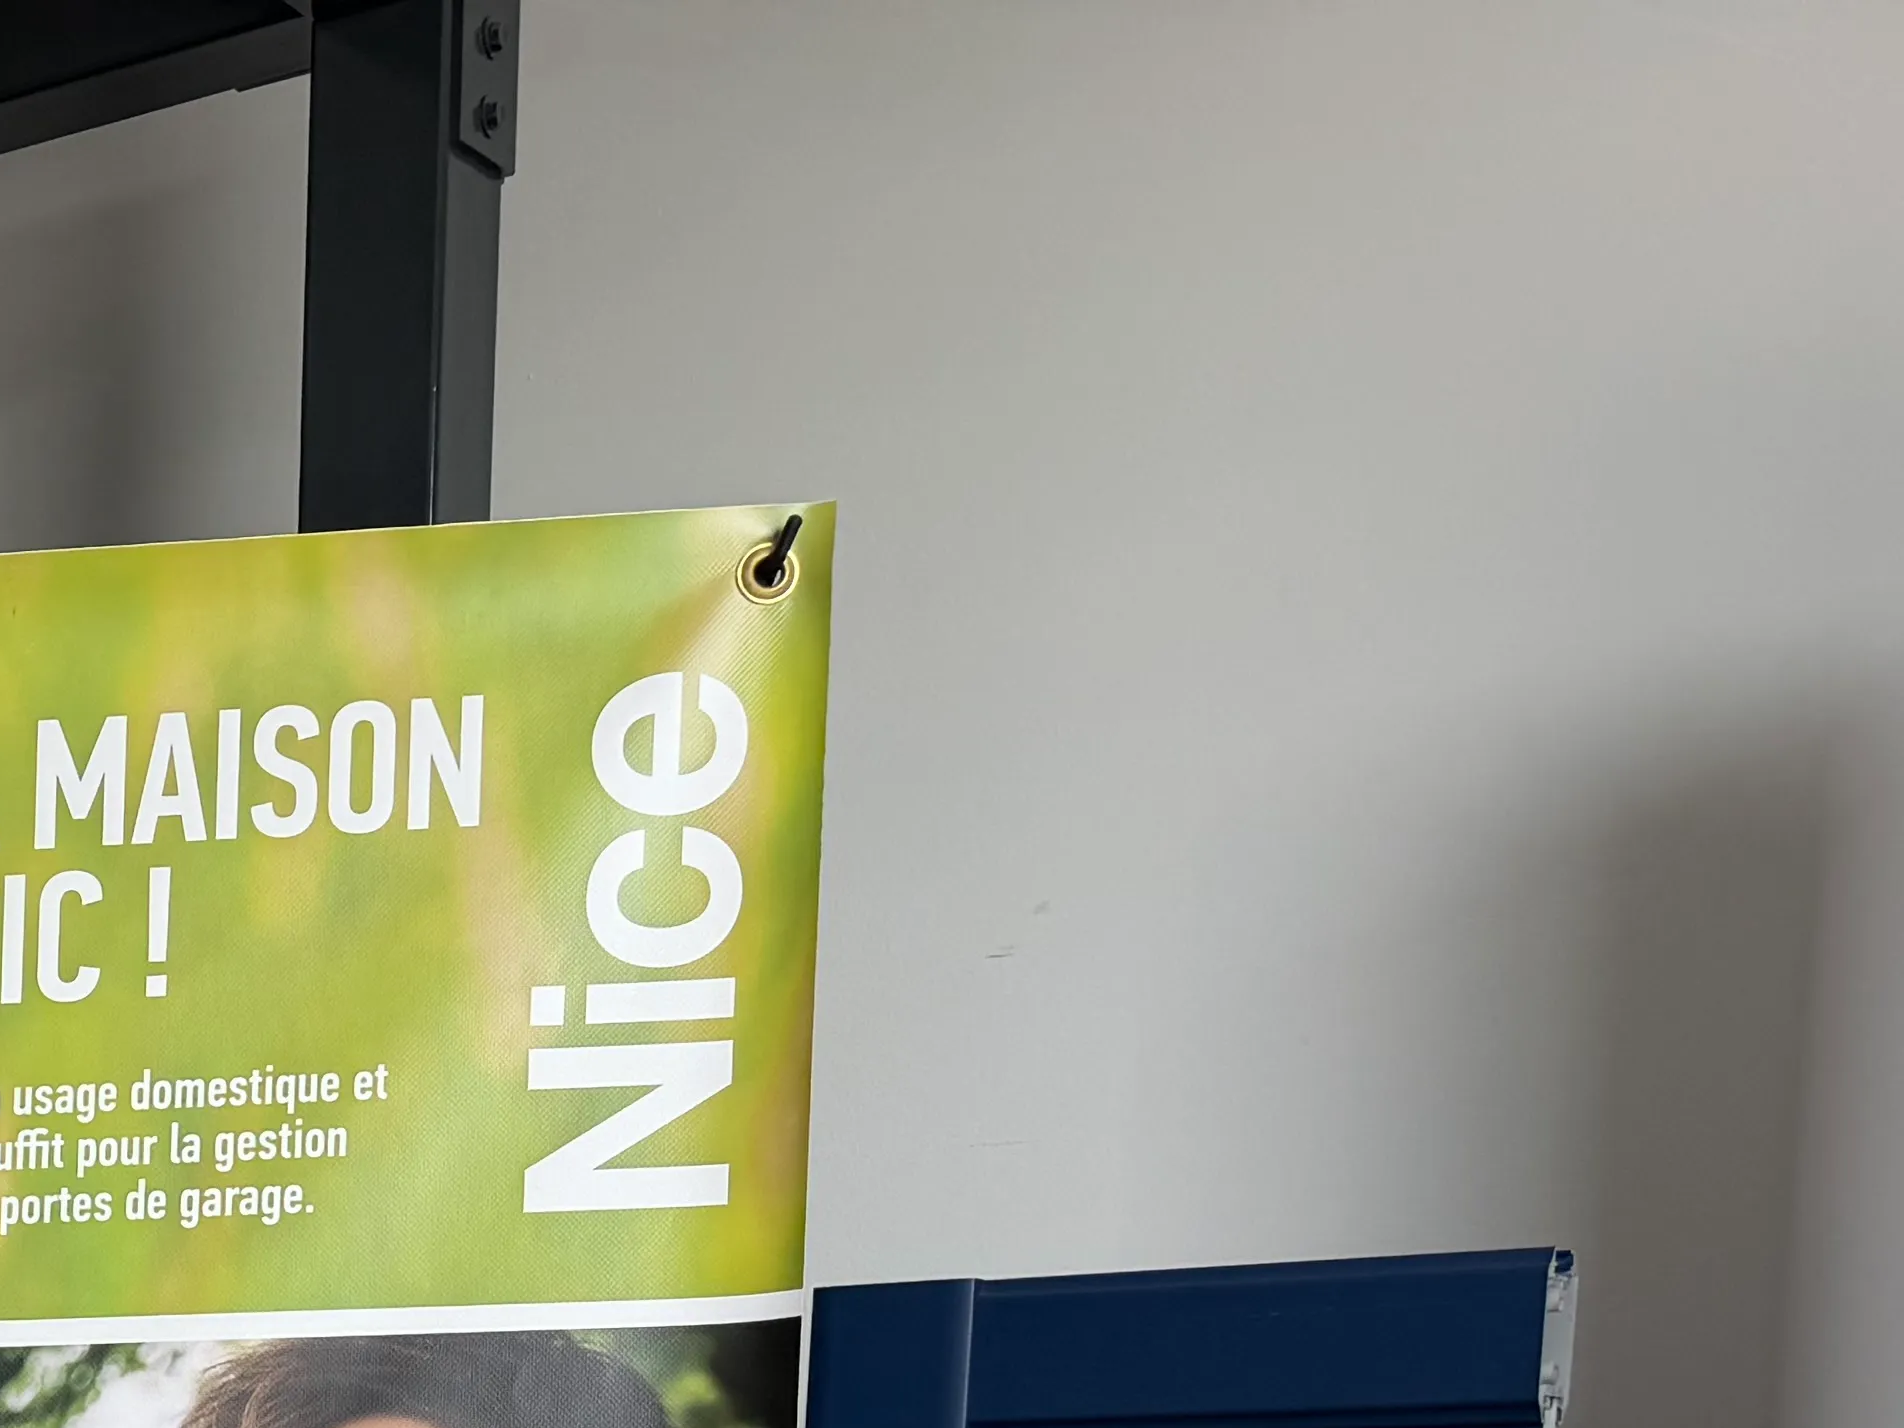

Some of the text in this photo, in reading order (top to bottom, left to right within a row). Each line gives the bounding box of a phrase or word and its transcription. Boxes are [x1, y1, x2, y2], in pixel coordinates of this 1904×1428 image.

[34, 694, 484, 850] MAISON
[145, 866, 172, 998] !
[523, 660, 749, 1213] Nice
[13, 1082, 118, 1124] usage
[131, 1064, 340, 1114] domestique
[353, 1063, 389, 1101] et
[77, 1135, 158, 1178] pour
[170, 1121, 201, 1164] la
[214, 1118, 348, 1173] gestion
[0, 1187, 113, 1236] portes
[125, 1178, 167, 1221] de
[180, 1184, 314, 1229] garage.
